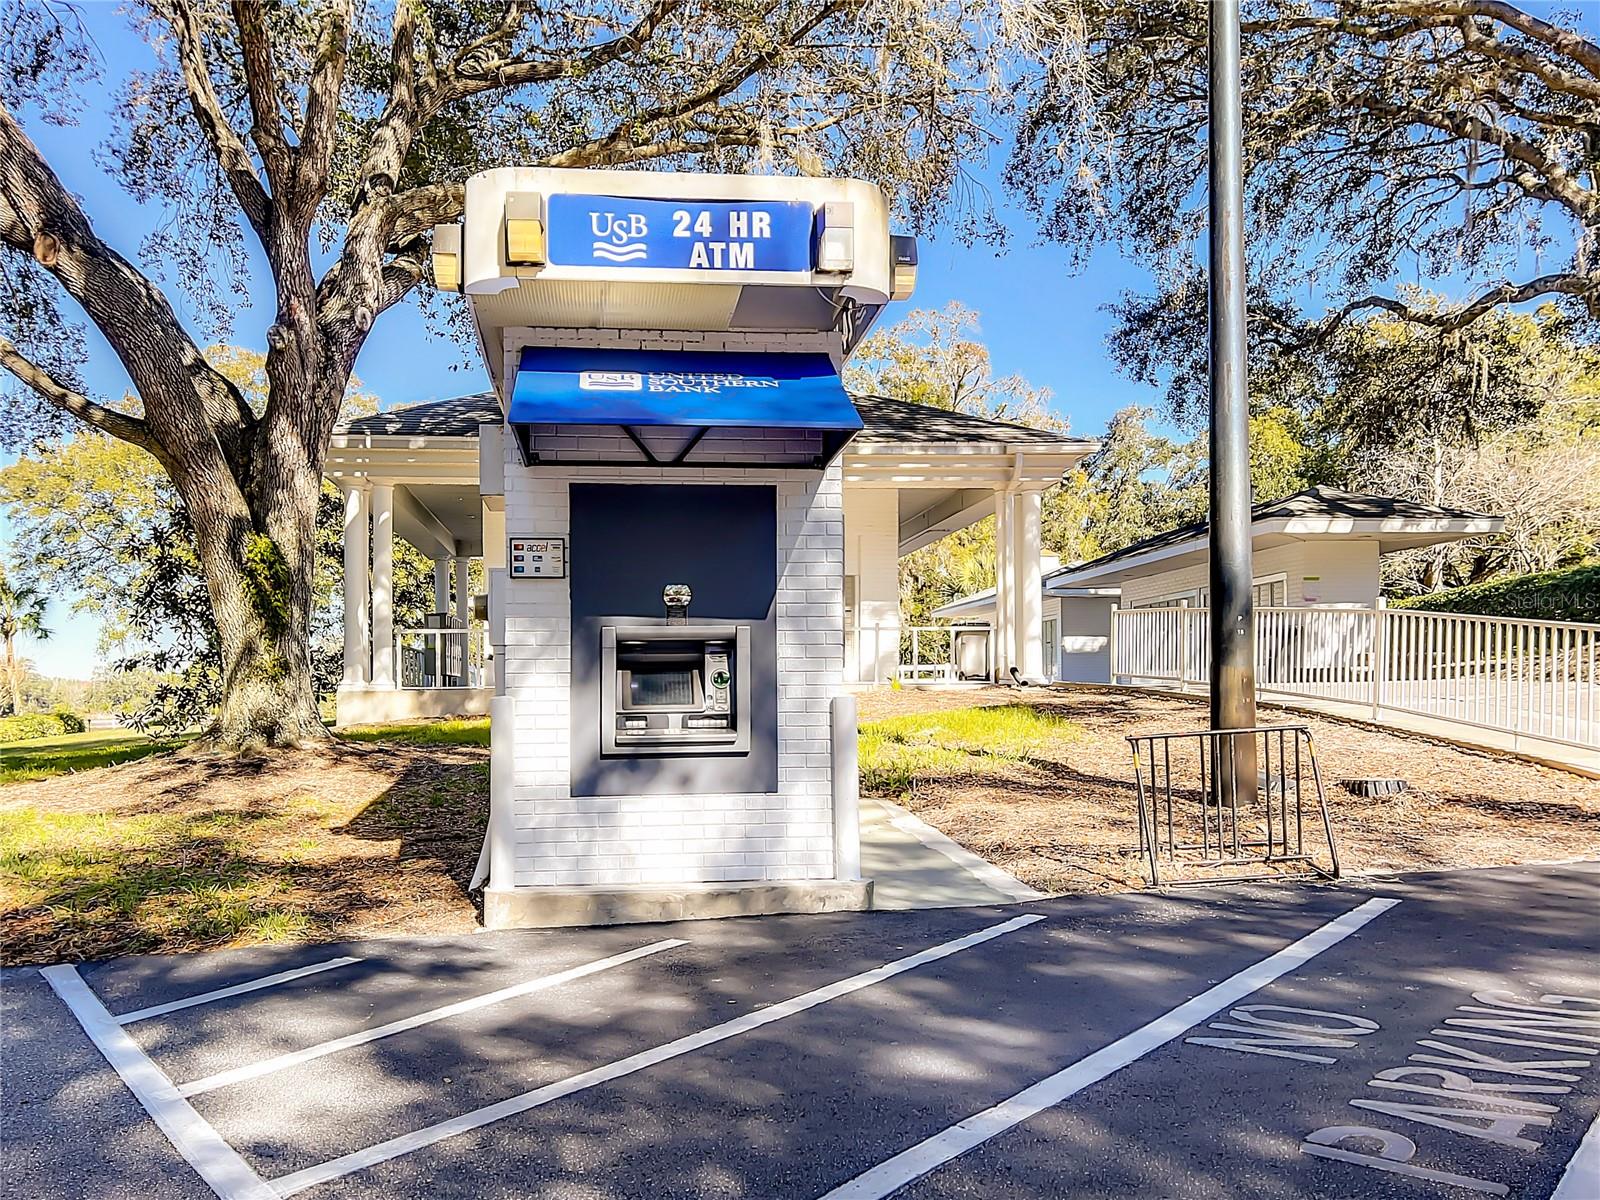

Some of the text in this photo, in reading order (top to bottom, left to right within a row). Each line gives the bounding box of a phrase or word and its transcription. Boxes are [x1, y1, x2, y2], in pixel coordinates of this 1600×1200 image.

[672, 210, 771, 238] 24 HR
[689, 241, 754, 269] ATM
[648, 372, 743, 380] UNITED
[648, 379, 779, 388] SOUTHERN
[649, 385, 721, 393] BANK
[526, 541, 549, 553] accel
[1185, 1004, 1380, 1064] NO
[1300, 990, 1600, 1196] PARKING
